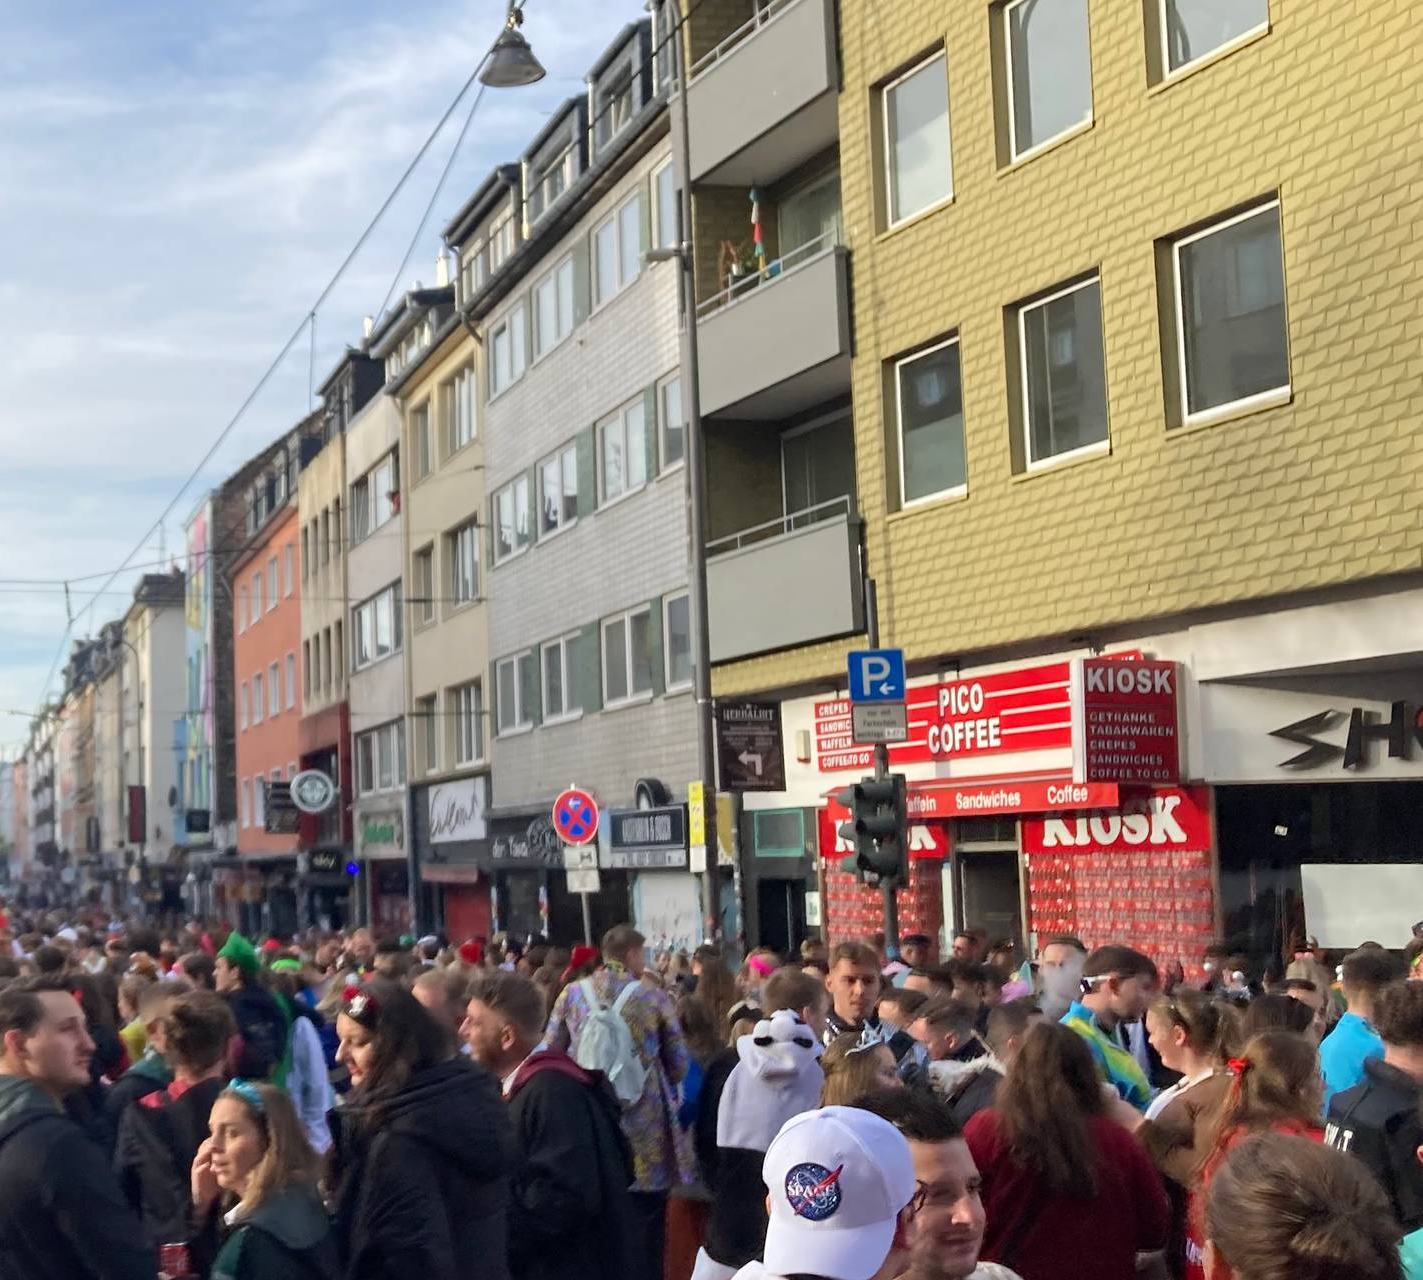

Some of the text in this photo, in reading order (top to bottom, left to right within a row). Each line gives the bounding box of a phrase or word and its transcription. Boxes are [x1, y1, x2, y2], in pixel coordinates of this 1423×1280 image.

[861, 656, 891, 696] P
[1087, 667, 1172, 694] KIOSK
[939, 682, 984, 717] PICO
[819, 720, 851, 733] SANDWIC
[928, 717, 1002, 753] COFFEE
[1089, 725, 1175, 737] TABAKWAREN
[859, 753, 869, 764] GO
[1089, 754, 1163, 765] SANDWICHES
[1090, 768, 1133, 778] COFFEE
[1137, 768, 1150, 778] TO
[907, 785, 1089, 812] affeln Sandwiches Coffee
[787, 1180, 836, 1199] SPACE
